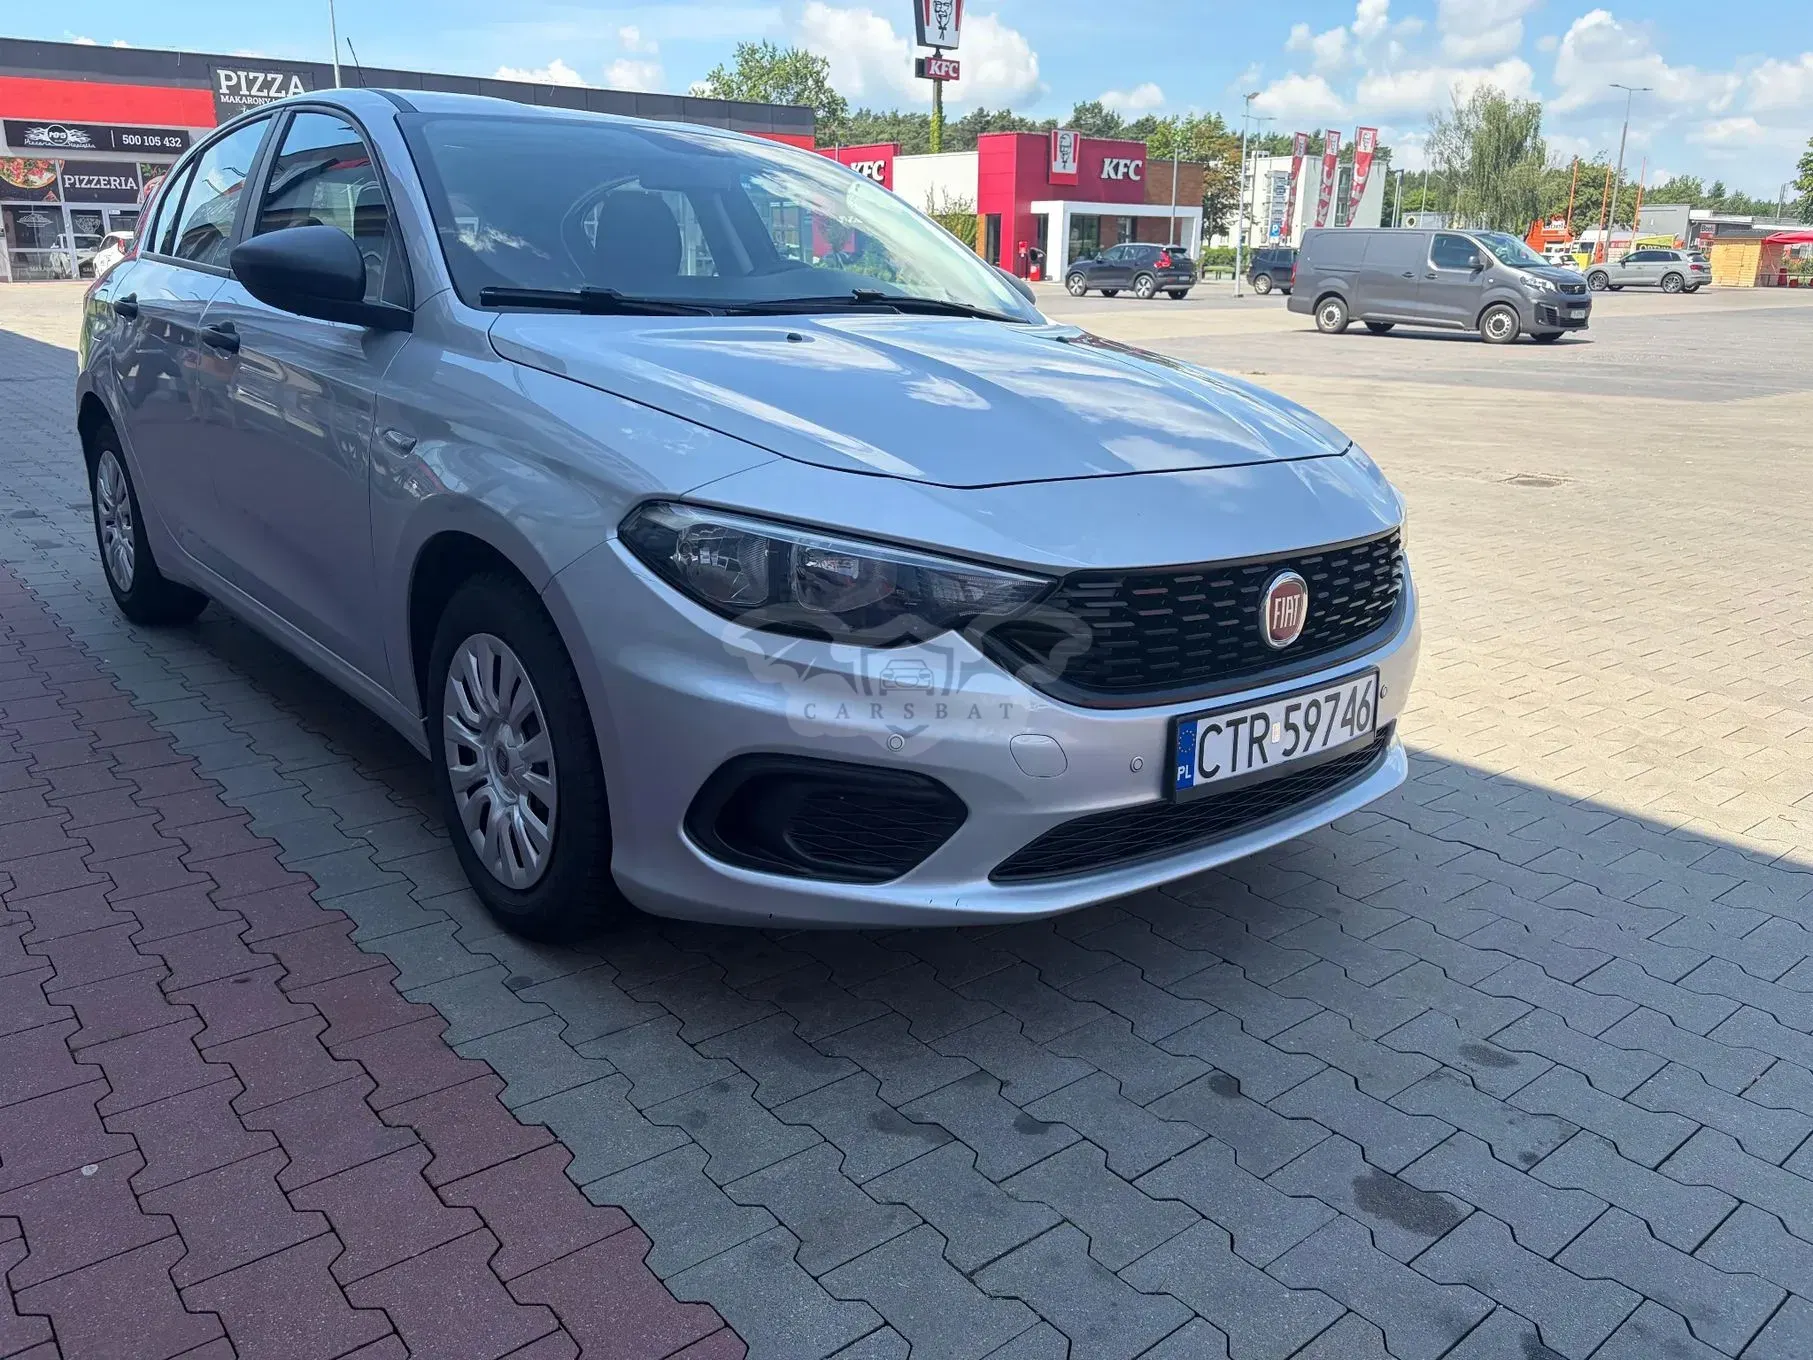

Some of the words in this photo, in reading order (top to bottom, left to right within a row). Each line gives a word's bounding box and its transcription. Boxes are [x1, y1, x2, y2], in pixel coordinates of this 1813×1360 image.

[929, 59, 959, 77] KFC
[216, 69, 305, 98] PIZZA
[219, 94, 271, 105] MAKARONY
[122, 134, 141, 145] 500
[143, 136, 161, 147] 105
[163, 136, 182, 148] 432
[1101, 158, 1143, 181] KFC
[63, 174, 138, 190] PIZZERIA
[1272, 593, 1301, 630] FIAT
[1198, 711, 1271, 779] CTR
[1281, 679, 1373, 757] 59746
[1176, 766, 1192, 781] PL
